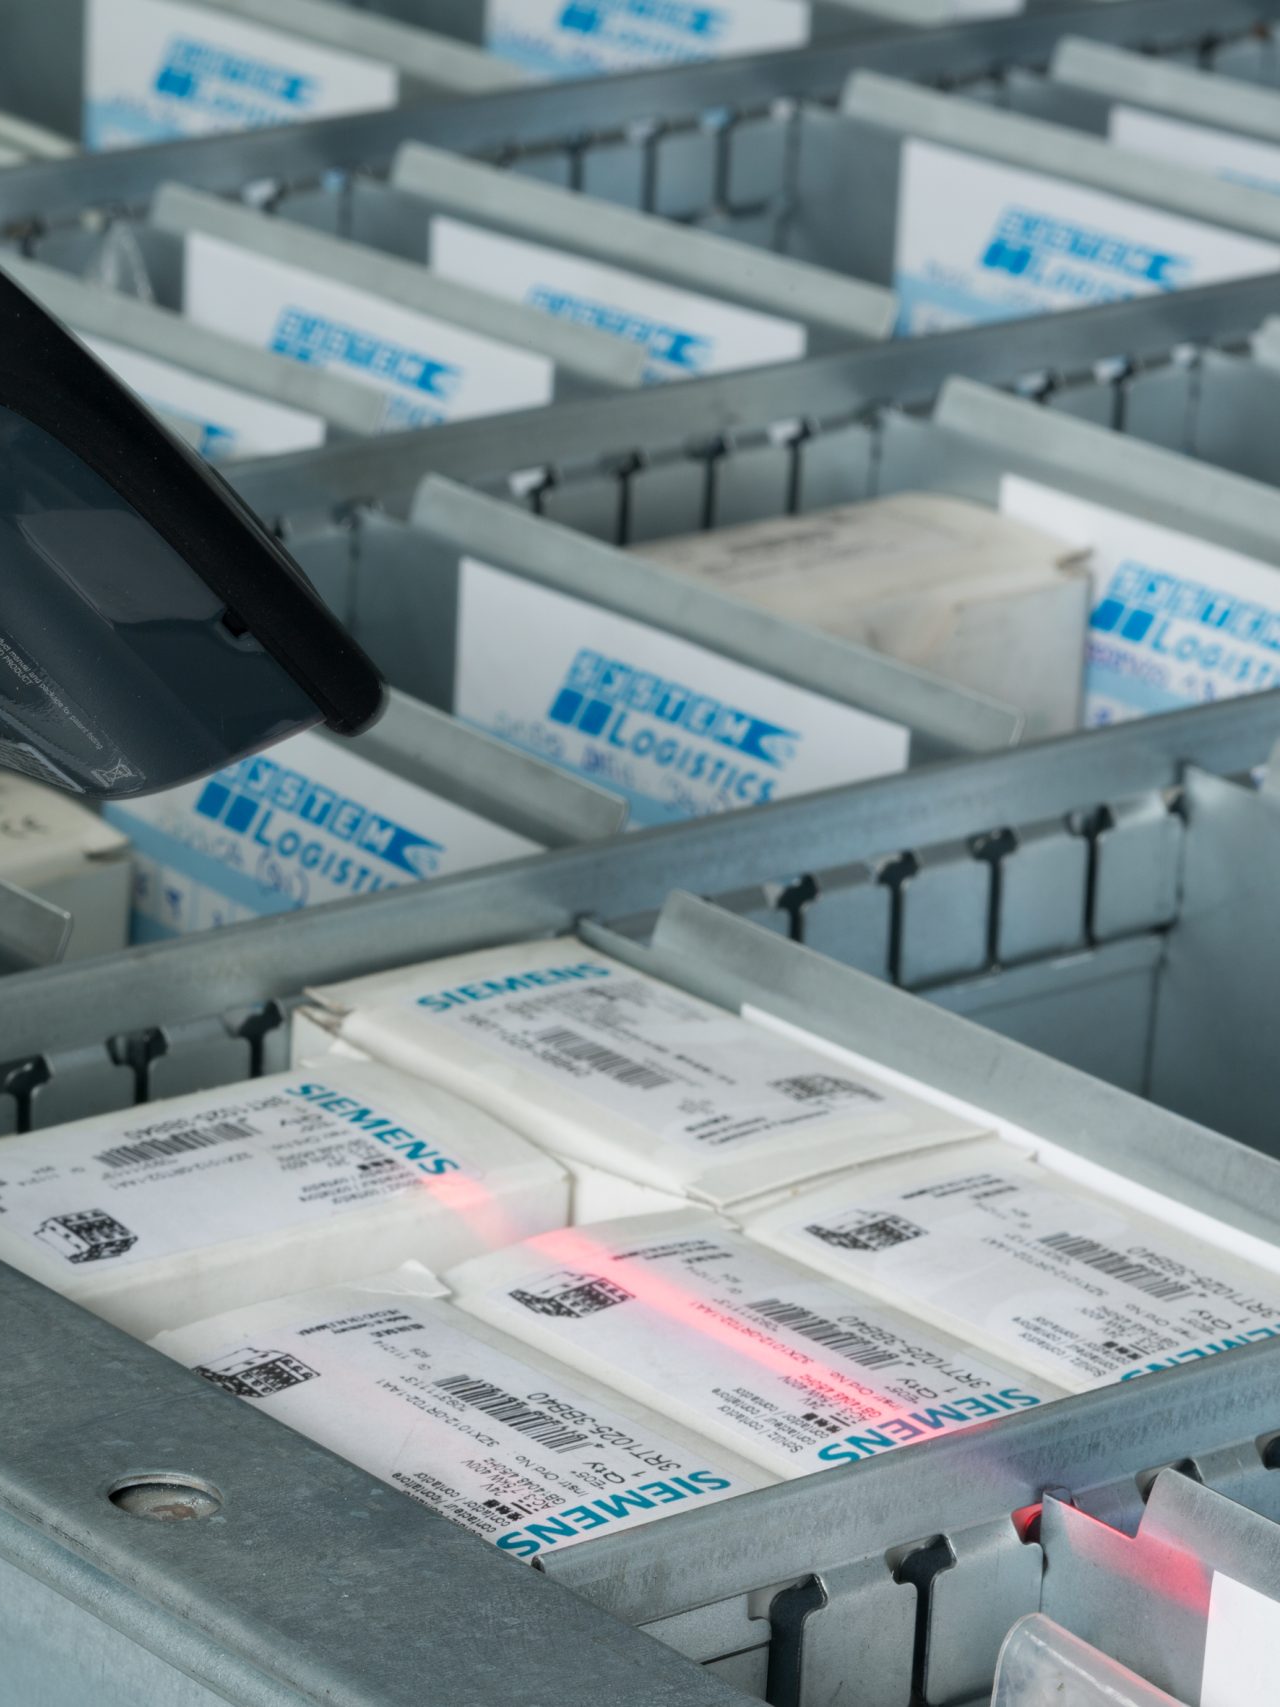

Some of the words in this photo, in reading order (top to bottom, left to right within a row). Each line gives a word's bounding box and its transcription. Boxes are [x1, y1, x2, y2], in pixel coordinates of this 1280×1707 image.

[2, 654, 33, 687] PRODUCT
[8, 649, 31, 674] manual
[28, 670, 42, 685] and
[38, 682, 64, 709] package
[68, 714, 88, 735] patent
[607, 709, 778, 806] LOGISTICS
[417, 961, 612, 1014] SIEMENS
[285, 1083, 461, 1176] SIEMENS
[832, 1314, 996, 1389] 3RT1025-3BB40
[728, 1387, 781, 1412] contactor
[891, 1376, 946, 1399] Qty
[523, 1390, 684, 1472] 3RT1025-3BB40
[712, 1404, 767, 1431] contactor
[760, 1417, 820, 1446] contacteur
[778, 1413, 833, 1439] contactor
[818, 1386, 1041, 1469] SIEMENS
[459, 1458, 494, 1475] 400V
[579, 1459, 632, 1484] Qty
[387, 1471, 442, 1501] contattore
[410, 1471, 462, 1497] contactor
[478, 1481, 508, 1496] 24V
[440, 1502, 499, 1533] contacteur
[459, 1499, 512, 1527] contactor
[495, 1468, 733, 1558] SIEMENS
